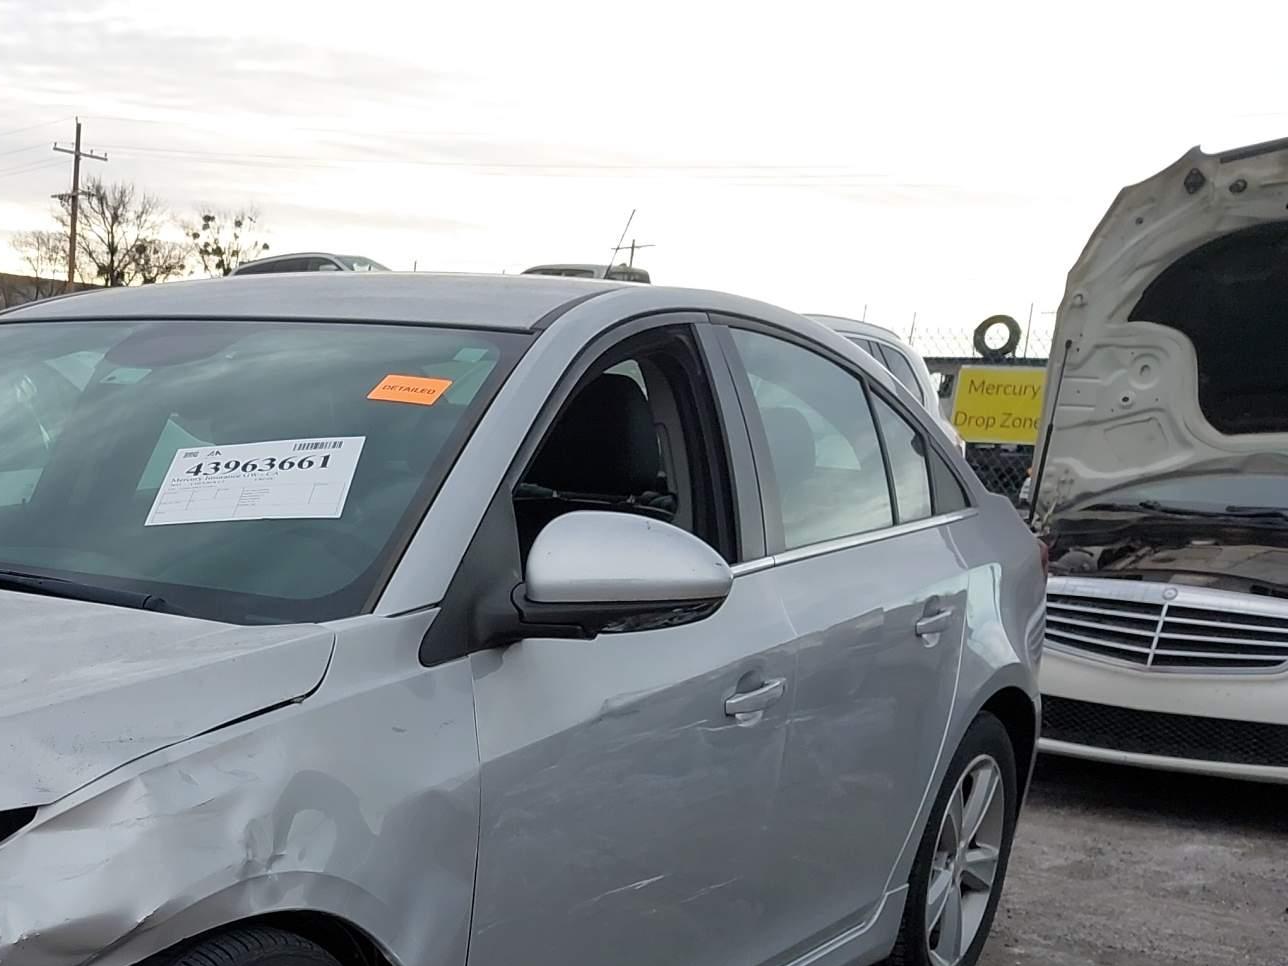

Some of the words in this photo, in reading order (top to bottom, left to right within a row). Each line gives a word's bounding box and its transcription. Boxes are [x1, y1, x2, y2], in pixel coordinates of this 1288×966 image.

[382, 384, 436, 395] DETAILED
[968, 379, 1040, 401] Mercury
[954, 410, 996, 430] Drop
[185, 454, 331, 477] 43963661
